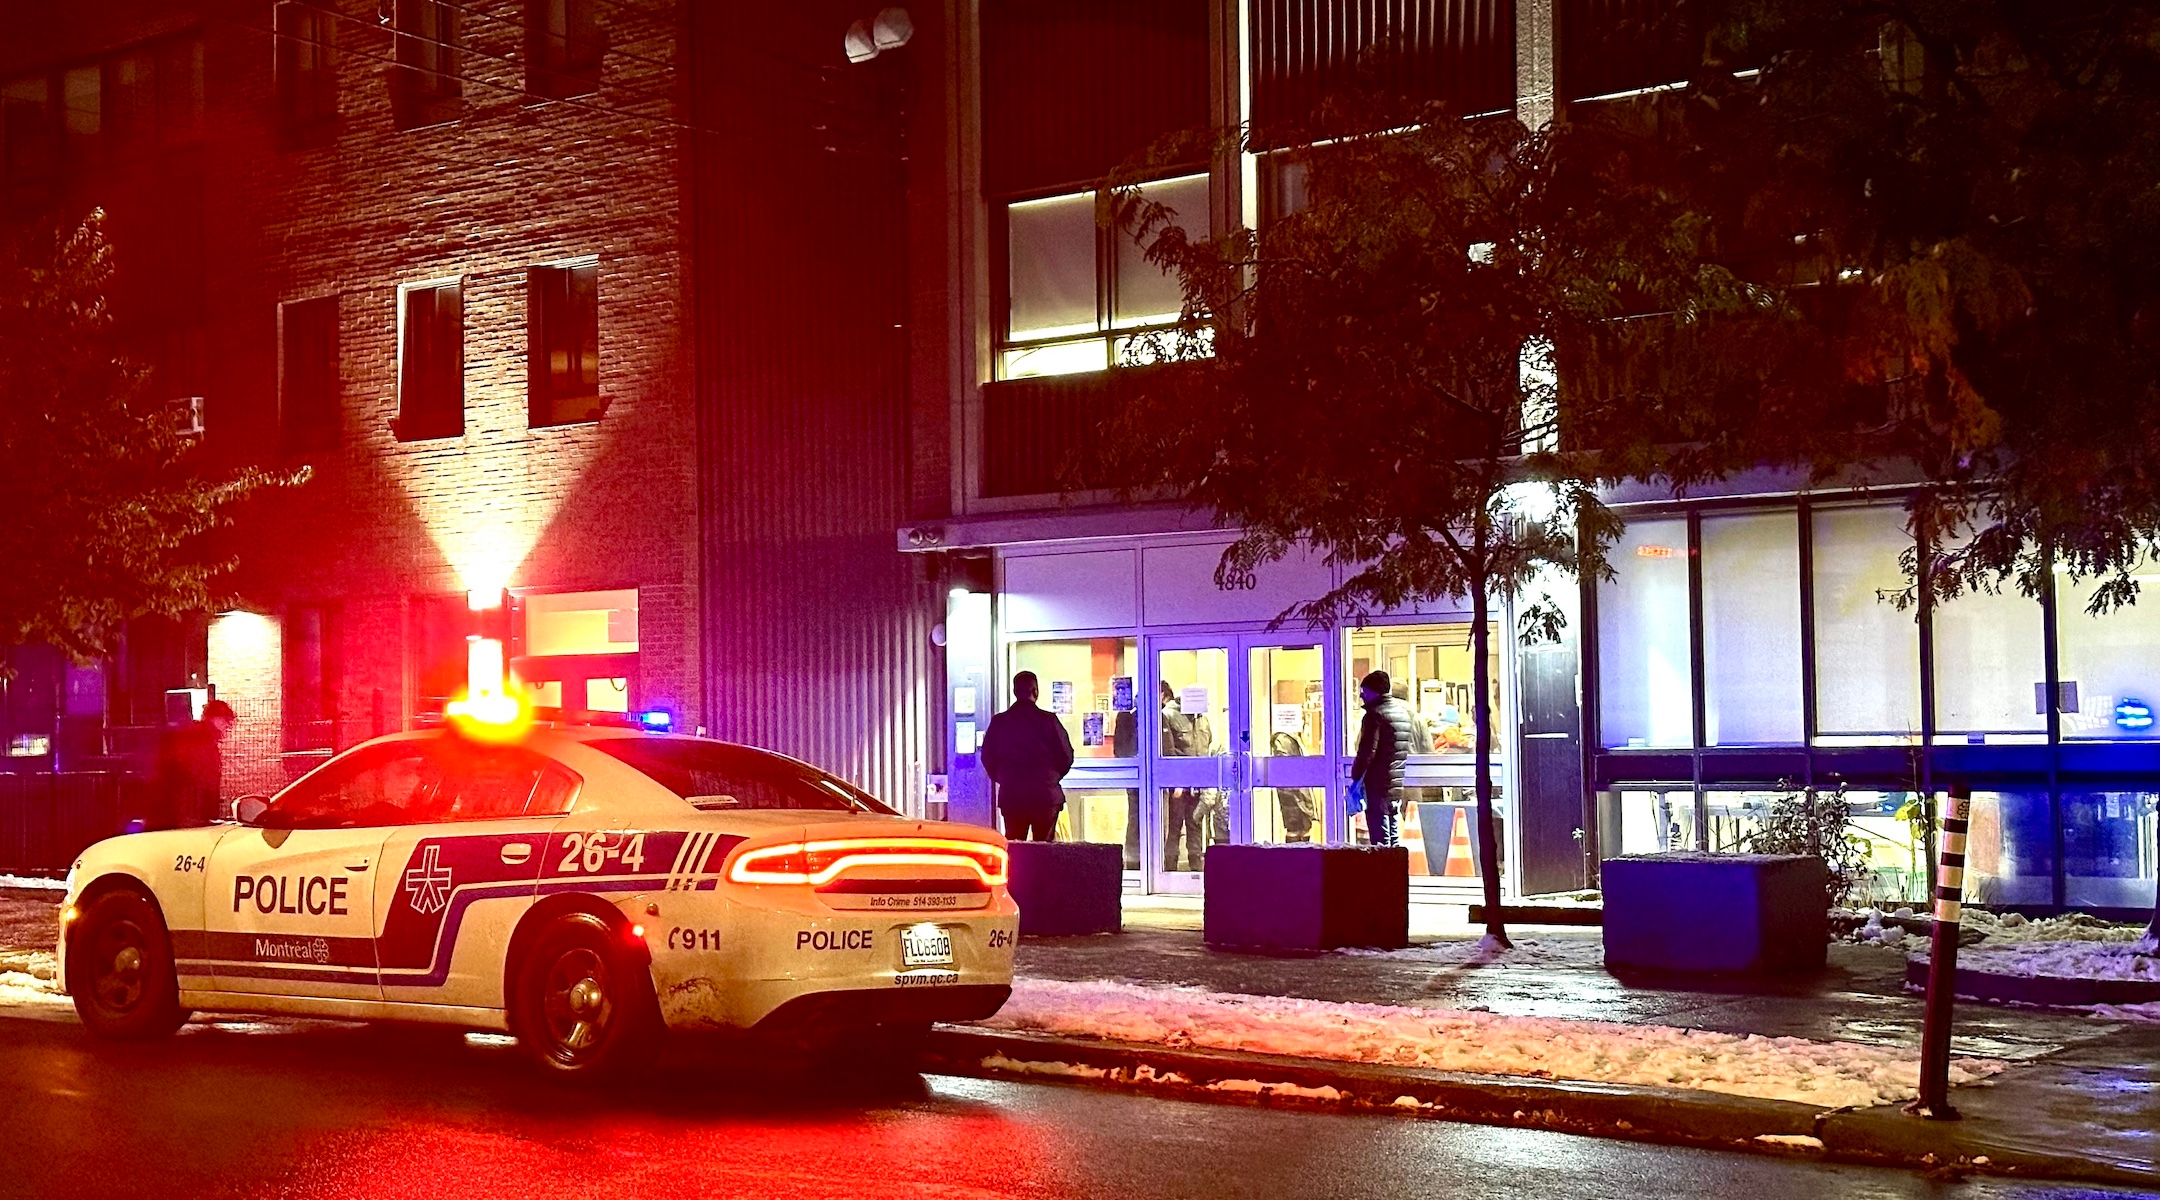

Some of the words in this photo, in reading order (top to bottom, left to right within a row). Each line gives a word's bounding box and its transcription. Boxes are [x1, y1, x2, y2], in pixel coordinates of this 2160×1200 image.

[1214, 573, 1256, 590] 4840
[558, 833, 645, 873] 26-4
[174, 855, 206, 872] 26-4
[233, 875, 348, 916] POLICE
[870, 897, 886, 906] Info
[887, 897, 910, 906] Crime
[682, 929, 720, 950] 911
[796, 930, 873, 950] POLICE
[989, 929, 1013, 948] 26-4
[255, 939, 313, 959] Montréal
[894, 973, 959, 987] spvm.qc.ca
